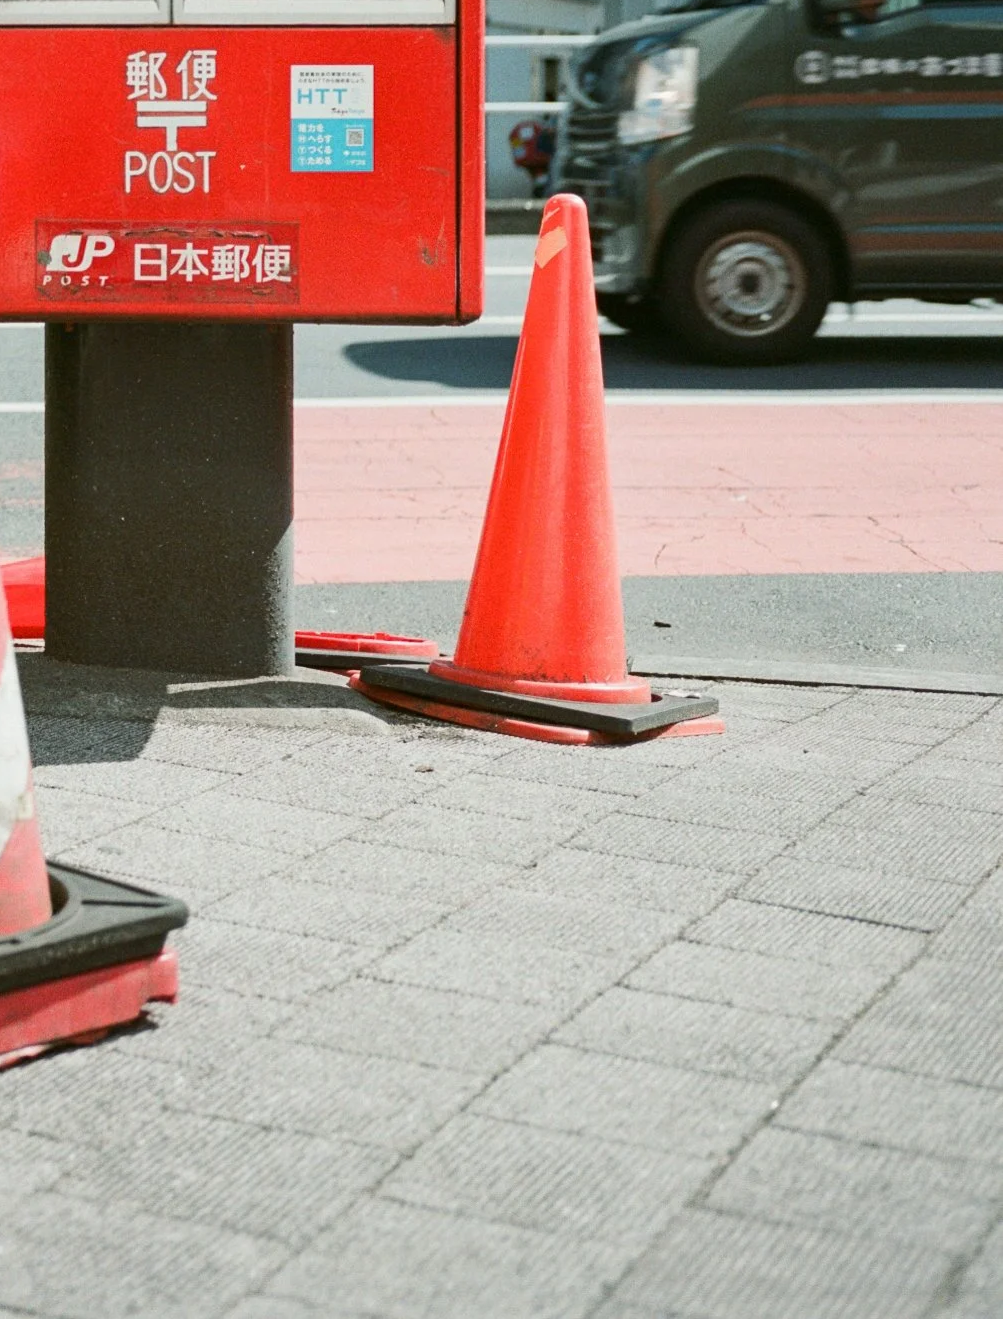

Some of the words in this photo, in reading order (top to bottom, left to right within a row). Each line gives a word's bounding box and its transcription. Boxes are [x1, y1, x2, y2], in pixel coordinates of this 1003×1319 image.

[126, 49, 218, 101] 郵便
[297, 88, 348, 105] HTT
[298, 123, 324, 133] 電力を
[124, 151, 216, 194] POST
[134, 242, 292, 283] 日本郵便
[42, 275, 110, 286] POST
